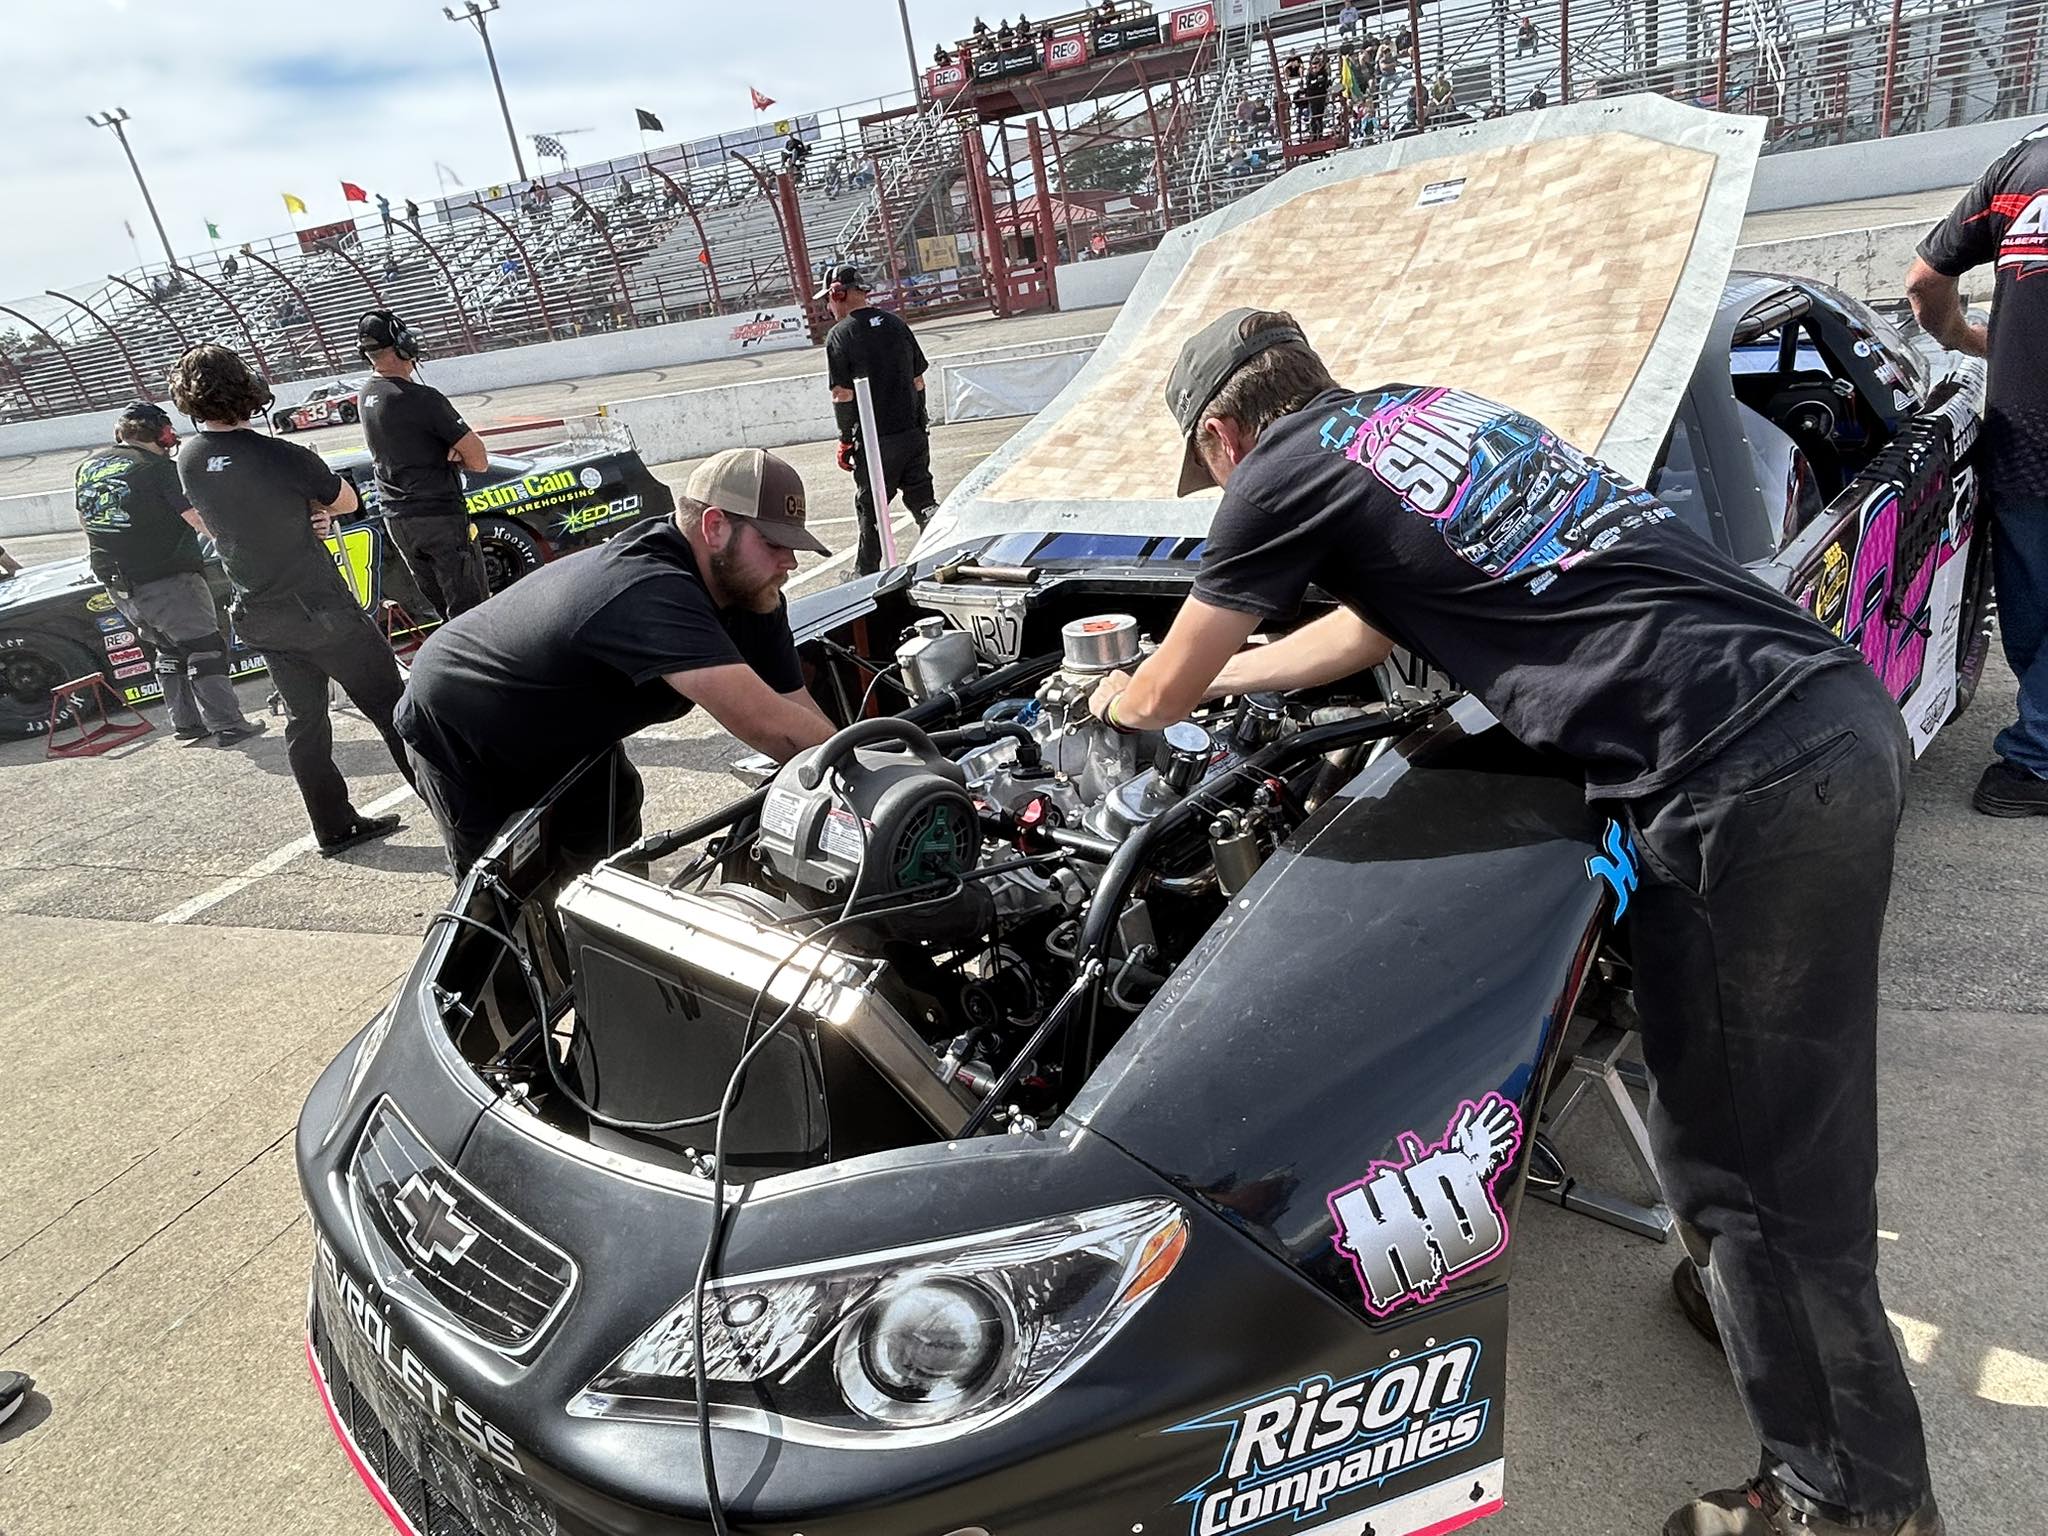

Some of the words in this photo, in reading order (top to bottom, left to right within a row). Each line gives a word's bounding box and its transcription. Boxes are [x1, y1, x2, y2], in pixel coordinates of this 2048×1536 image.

[306, 402, 328, 422] 33
[523, 469, 577, 496] Cain
[506, 488, 596, 516] WAREHOUSING
[582, 494, 638, 523] EDCO
[493, 526, 536, 566] Hoosier
[316, 1228, 448, 1417] EVROLET
[454, 1398, 526, 1476] SS
[1228, 1346, 1473, 1480] Rison
[1199, 1408, 1482, 1536] Companies
